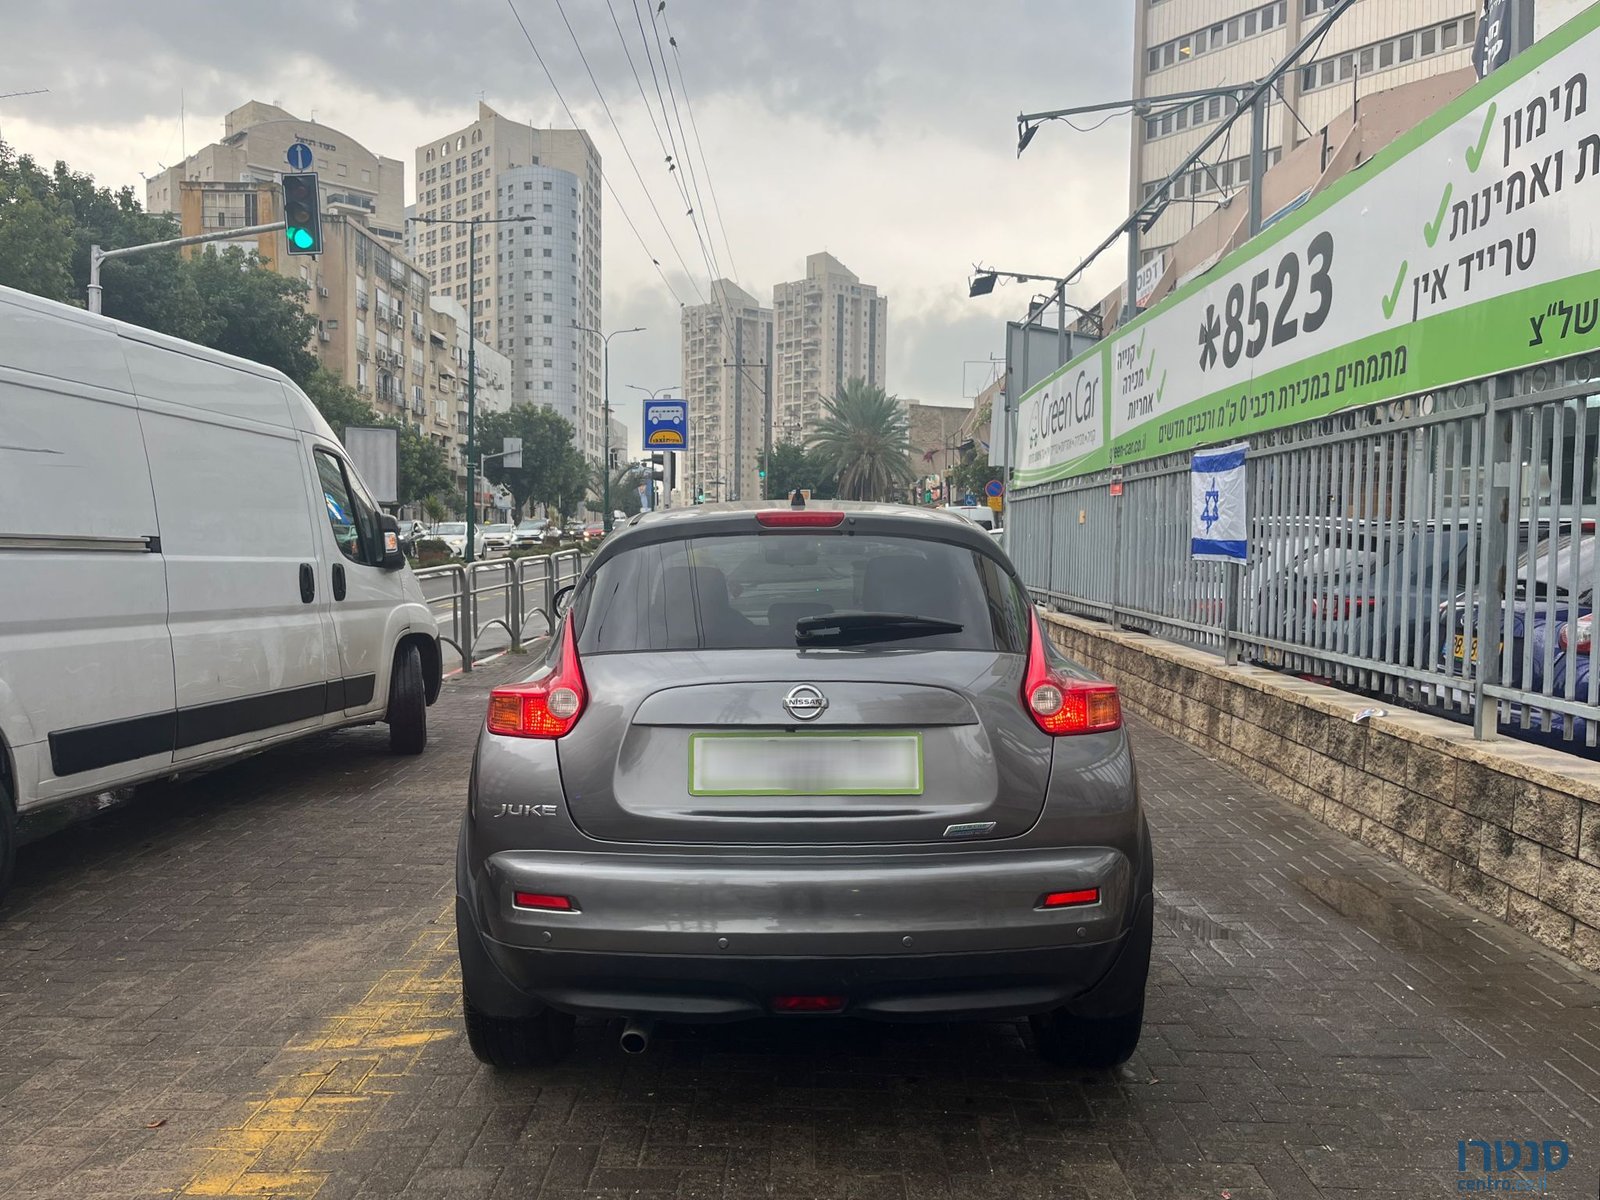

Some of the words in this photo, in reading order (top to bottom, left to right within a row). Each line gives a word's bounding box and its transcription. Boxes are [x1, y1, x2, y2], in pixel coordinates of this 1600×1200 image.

[1503, 72, 1587, 168] מימון
[1574, 133, 1600, 184] ת
[1449, 149, 1564, 242] ואמינות
[1458, 228, 1537, 292] טרייד
[1412, 264, 1450, 323] אין
[1117, 344, 1136, 371] קנייה
[1335, 345, 1407, 394] מתמחים
[1122, 368, 1144, 395] מכירה
[1278, 371, 1330, 411] במכירת
[1040, 393, 1072, 439] Green
[1075, 370, 1099, 424] Car
[1127, 393, 1154, 421] אחריות
[1217, 399, 1237, 427] ק"מ
[1239, 395, 1247, 421] 0
[1250, 390, 1275, 419] רכבי
[1158, 419, 1185, 444] חדשים
[1186, 409, 1216, 436] ורכבים
[788, 698, 823, 706] NISSAN
[493, 803, 558, 818] JUKE
